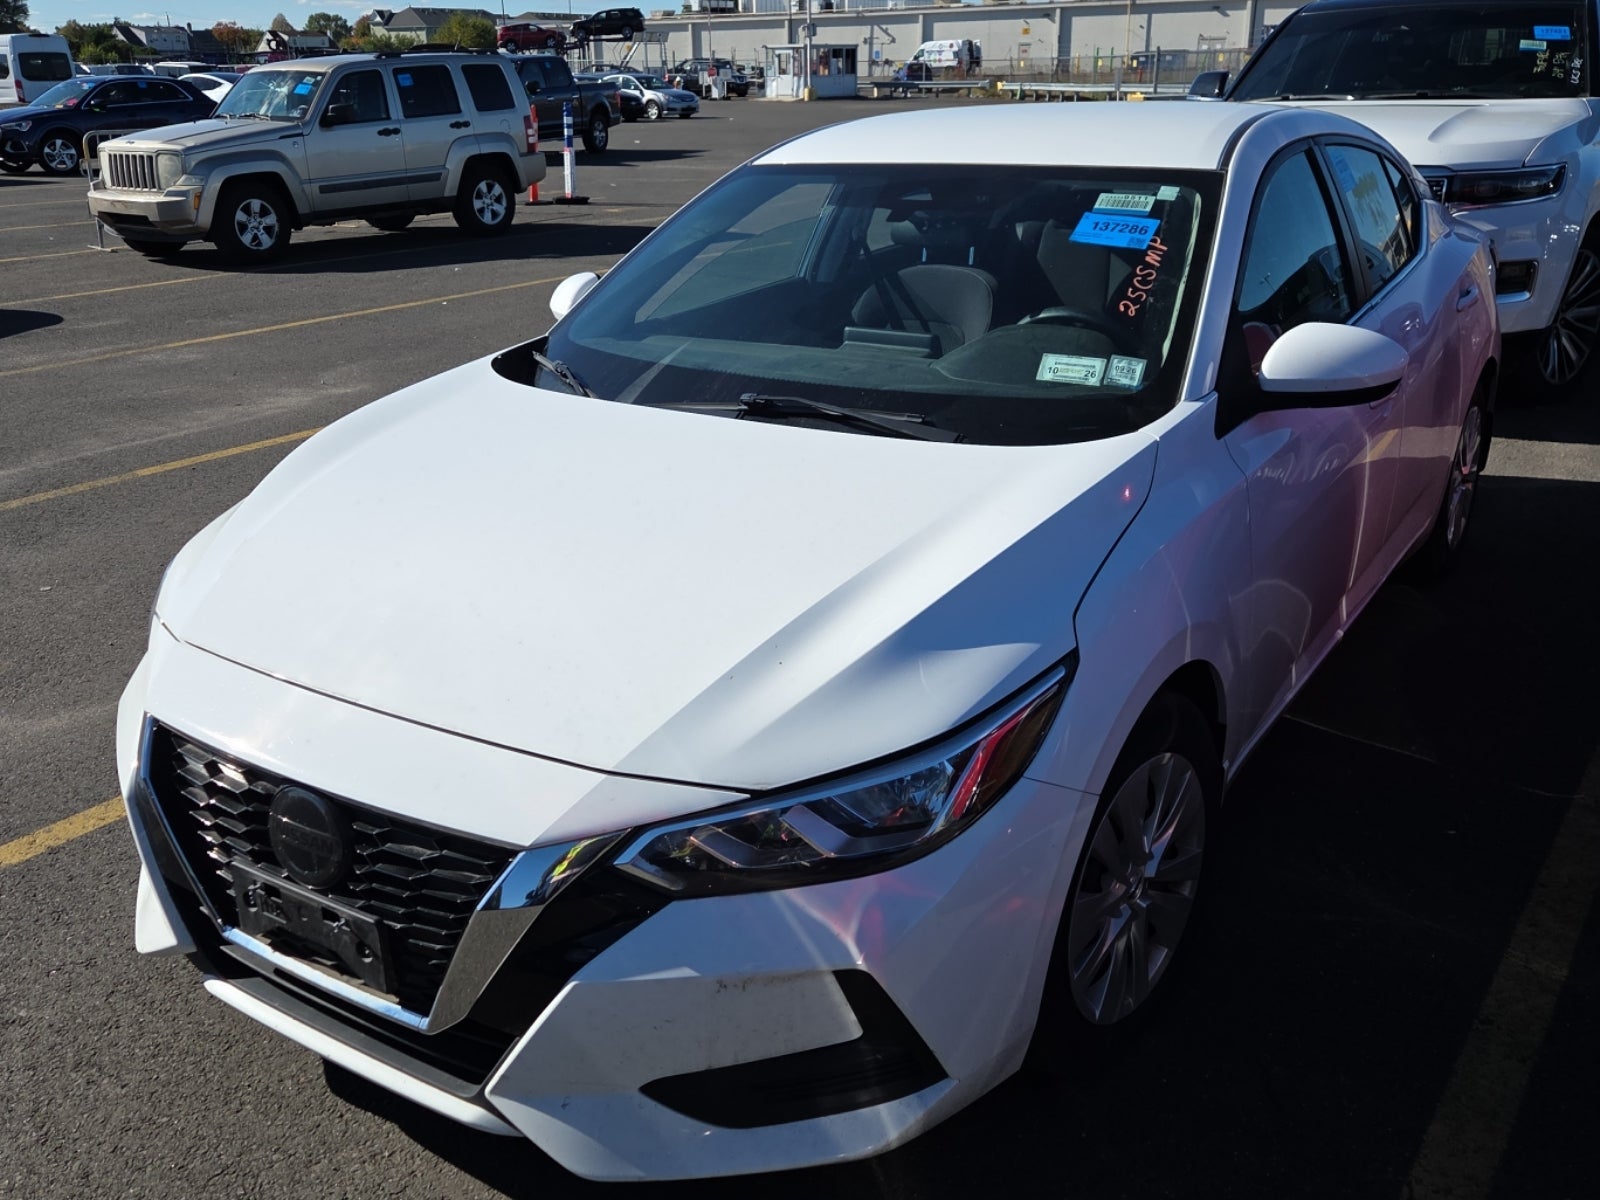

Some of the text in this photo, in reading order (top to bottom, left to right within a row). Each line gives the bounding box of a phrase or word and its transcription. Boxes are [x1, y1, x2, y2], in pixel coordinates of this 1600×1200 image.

[1092, 221, 1150, 236] 137286
[1047, 366, 1059, 375] 10
[1084, 370, 1097, 379] 26
